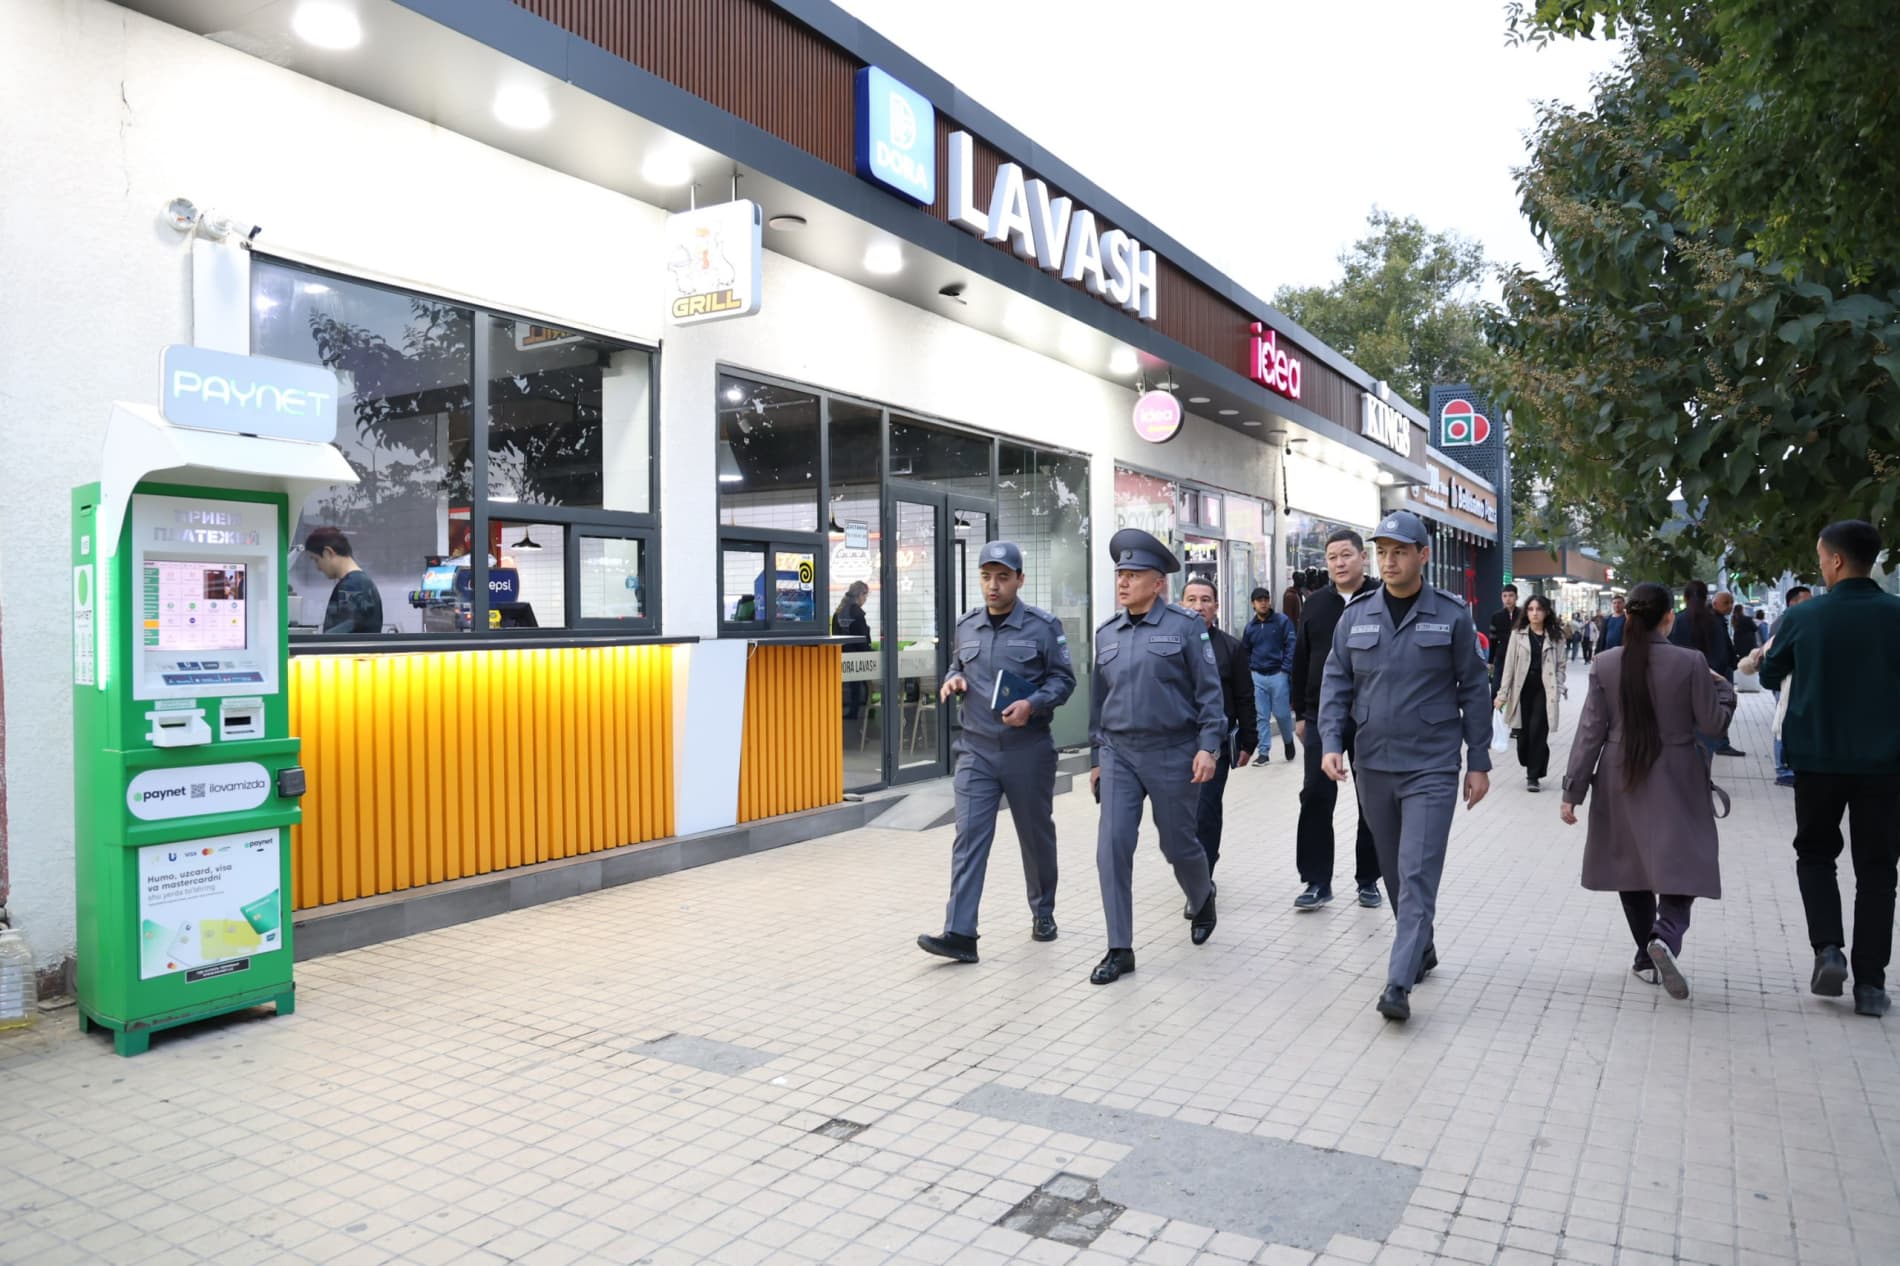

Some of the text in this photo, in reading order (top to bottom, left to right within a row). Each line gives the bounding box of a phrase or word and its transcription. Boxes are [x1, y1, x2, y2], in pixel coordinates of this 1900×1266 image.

[876, 139, 929, 190] DORA
[949, 129, 1157, 320] LAVASH
[672, 288, 742, 319] GRILL
[1250, 321, 1301, 401] idea
[172, 369, 331, 417] PAYNET
[1361, 391, 1411, 458] KINGS
[143, 779, 265, 802] paynet ilovamizda
[249, 838, 273, 848] paynet
[147, 873, 178, 883] Humo,
[215, 864, 233, 873] visa
[147, 874, 222, 893] va mastercardni
